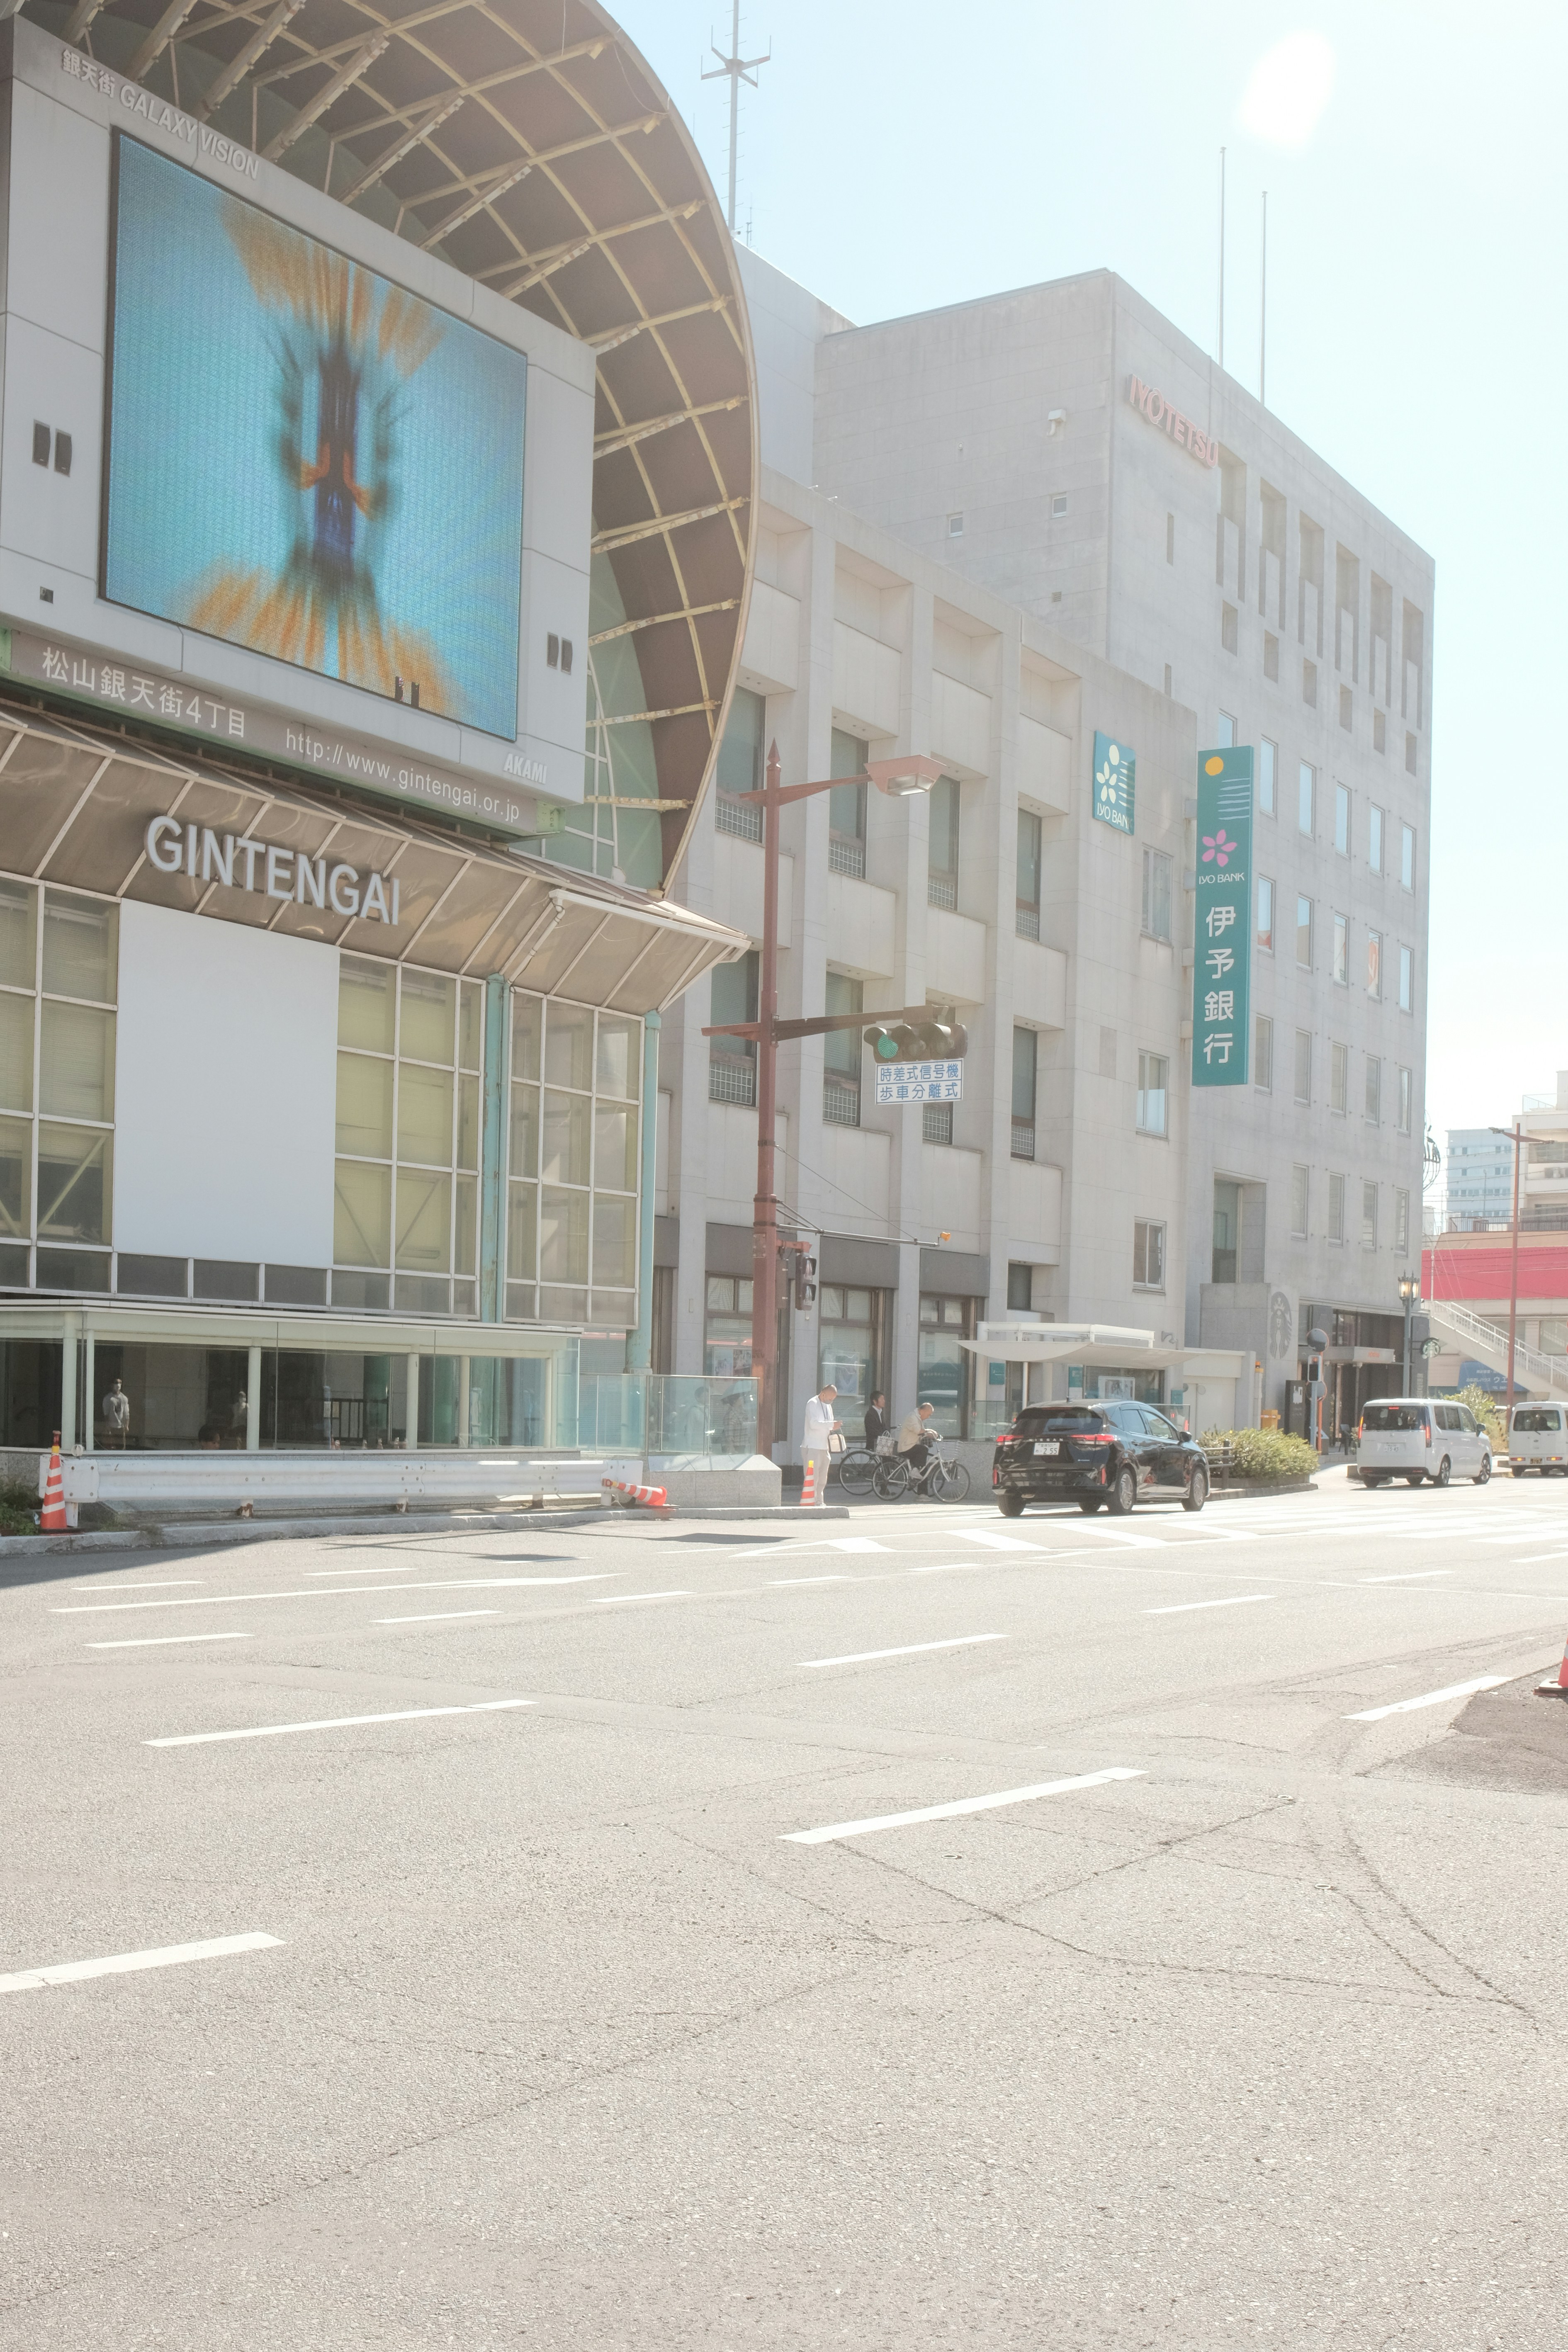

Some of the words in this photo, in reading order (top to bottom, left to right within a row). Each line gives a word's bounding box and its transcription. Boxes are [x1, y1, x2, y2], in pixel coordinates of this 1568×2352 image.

[61, 49, 116, 99] 銀天街
[120, 85, 198, 143] GALAXY
[200, 129, 259, 180] VISION
[1127, 374, 1218, 468] IYOTETSU
[42, 647, 246, 738] 松山銀天街4丁目
[286, 729, 520, 823] http://www.gintengai.or.jp
[503, 753, 548, 785] AKAMI
[1097, 802, 1111, 820] IYO
[145, 816, 401, 926] GINTENGAI
[1198, 875, 1215, 884] IYO
[1217, 872, 1245, 883] BANK
[1203, 906, 1236, 1064] 伊予銀行
[880, 1063, 959, 1082] 時差式信号機
[880, 1082, 958, 1101] 歩車分離式
